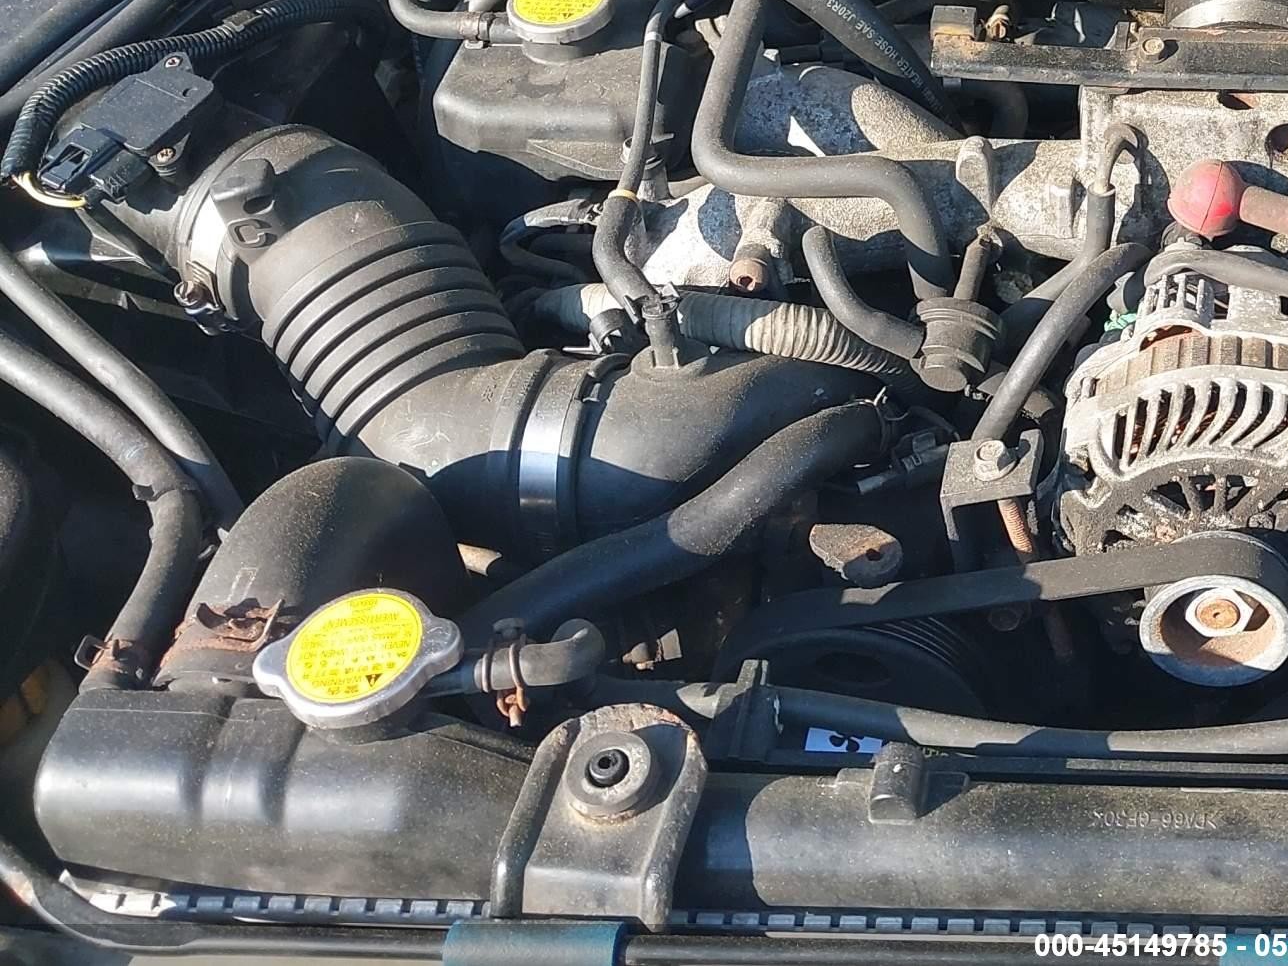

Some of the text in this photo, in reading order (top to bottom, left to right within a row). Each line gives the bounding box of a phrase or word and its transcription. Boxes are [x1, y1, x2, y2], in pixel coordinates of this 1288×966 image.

[826, 0, 856, 22] J20R3
[855, 21, 876, 38] SAE
[874, 35, 899, 59] HOSE
[312, 675, 362, 687] WARNING
